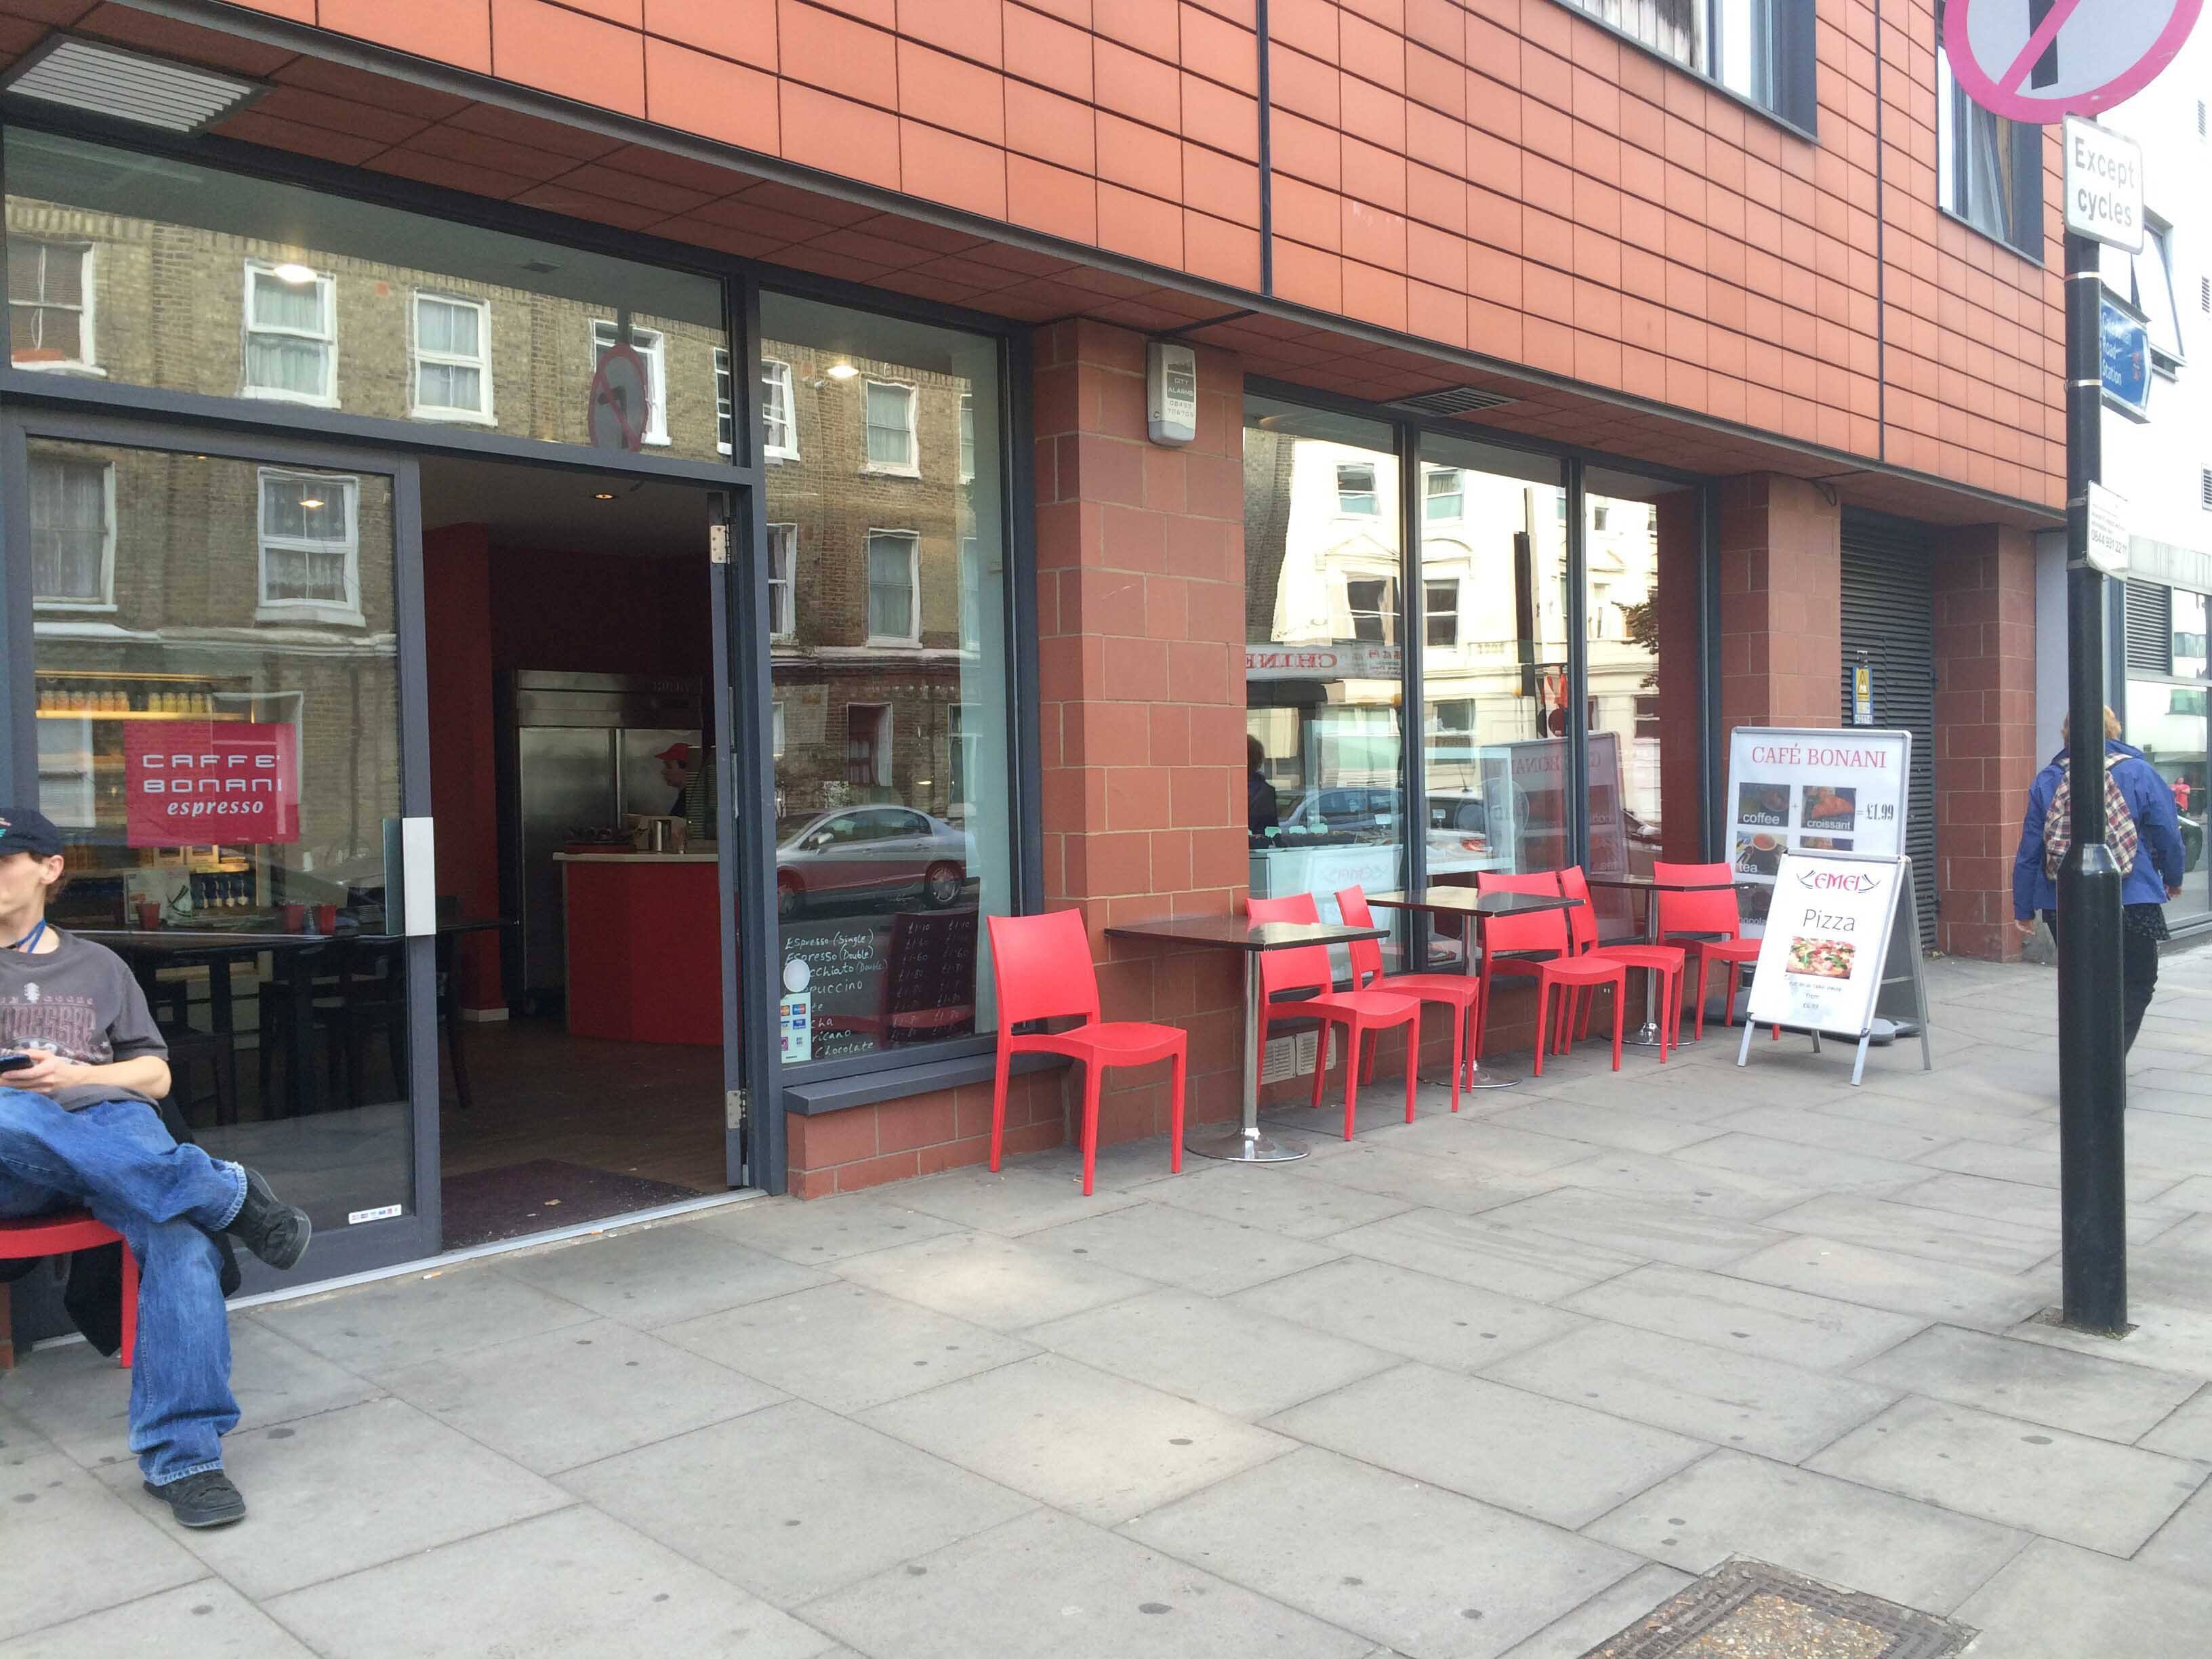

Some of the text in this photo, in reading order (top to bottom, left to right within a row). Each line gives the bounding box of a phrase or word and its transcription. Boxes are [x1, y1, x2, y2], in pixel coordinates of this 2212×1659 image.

[2074, 136, 2135, 189] Except
[2077, 188, 2133, 228] cycles
[2102, 358, 2122, 386] Station
[1174, 377, 1189, 386] CITY
[1168, 386, 1194, 396] ALARMS
[2091, 529, 2105, 546] 0844
[1752, 743, 1887, 769] CAFÉ BONANI
[143, 778, 282, 793] BONANI
[167, 800, 264, 817] espresso
[1866, 803, 1895, 821] £1.99
[1742, 813, 1780, 825] coffee
[1807, 819, 1851, 831] croissant
[1739, 861, 1758, 873] tea
[1814, 873, 1861, 891] EMEI
[1803, 909, 1856, 933] Pizza
